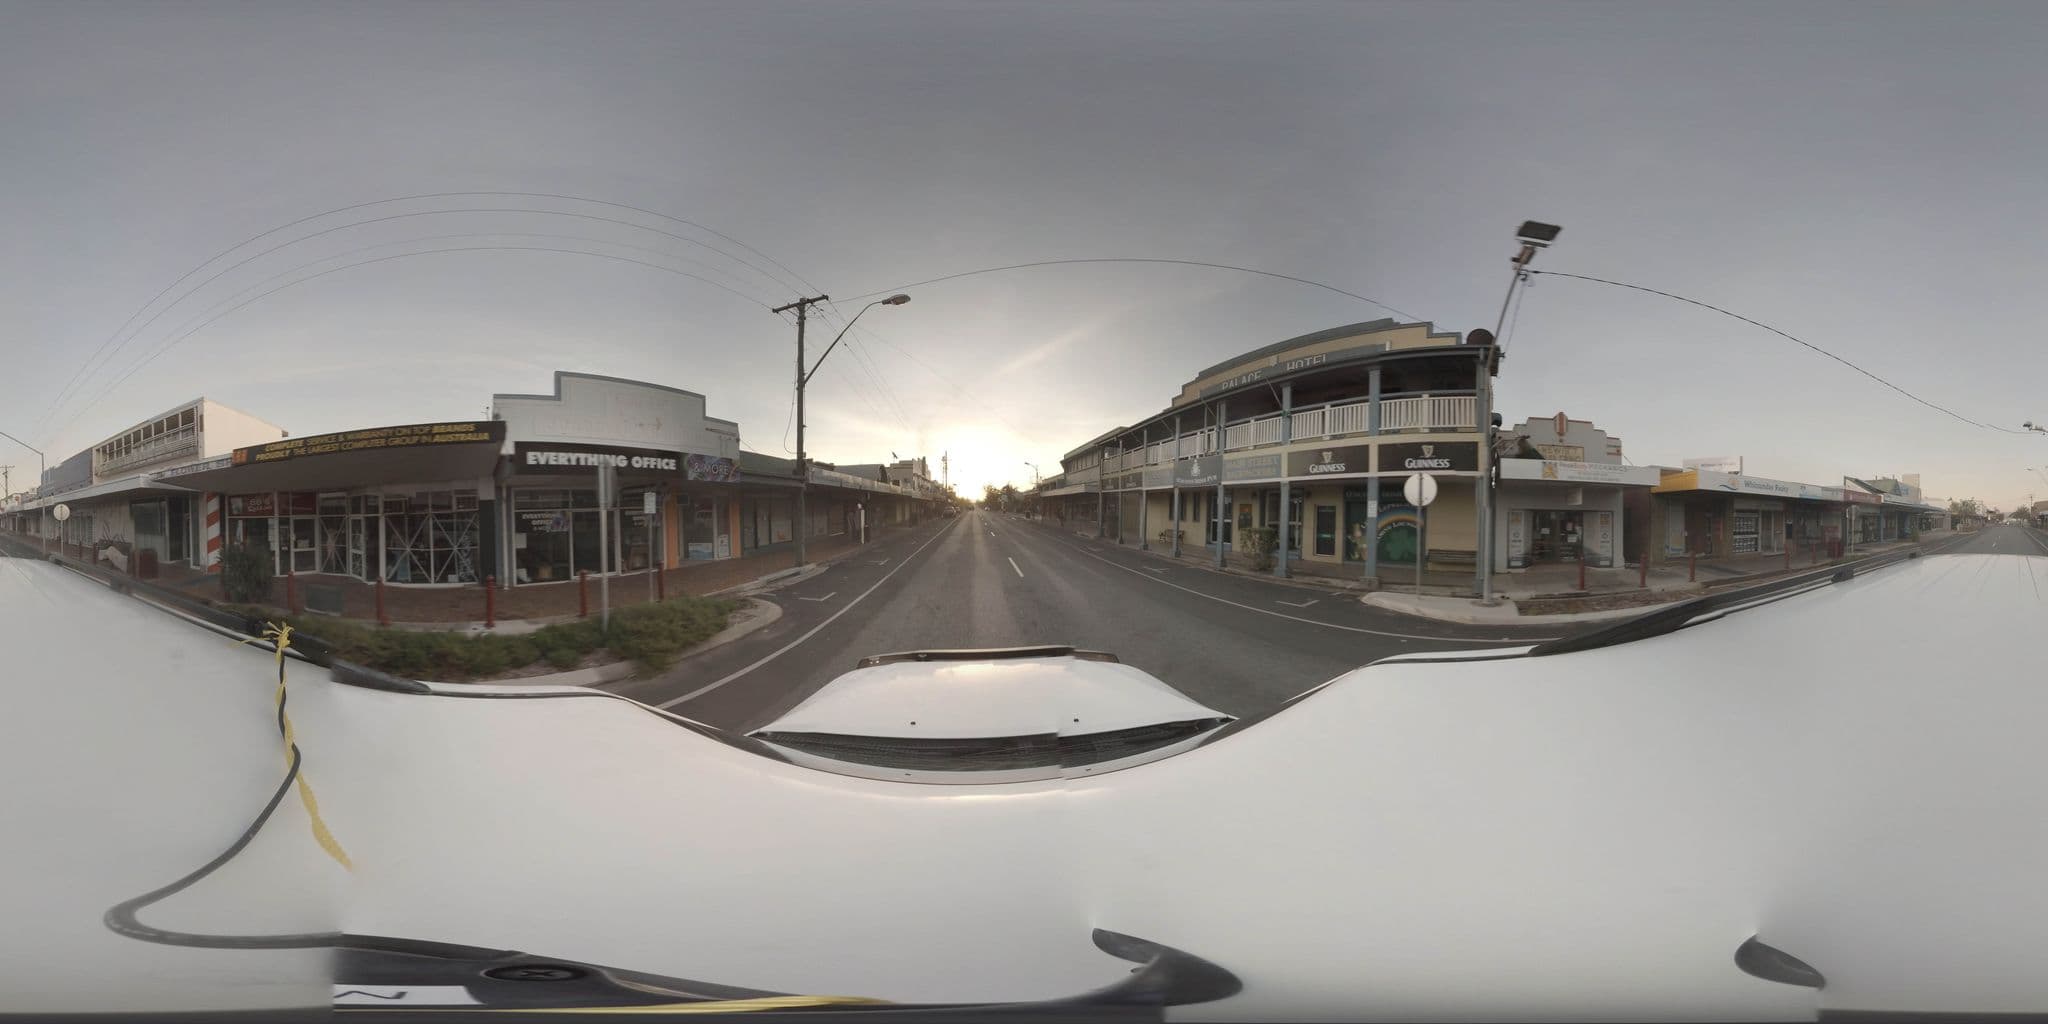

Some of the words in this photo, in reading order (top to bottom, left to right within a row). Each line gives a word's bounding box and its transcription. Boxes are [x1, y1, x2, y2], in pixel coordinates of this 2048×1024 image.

[1222, 370, 1262, 390] PALACE
[1286, 353, 1326, 371] HOTEL
[265, 440, 304, 451] COMPLETE
[307, 435, 338, 446] SERVICE
[432, 424, 476, 433] BRANDS
[433, 432, 490, 442] AUSTRALIA
[526, 451, 627, 468] EVERYTHING
[631, 455, 677, 470] OFFICE
[1404, 458, 1450, 469] GUINNESS
[702, 463, 730, 475] MORE
[1309, 463, 1346, 474] GUINNESS
